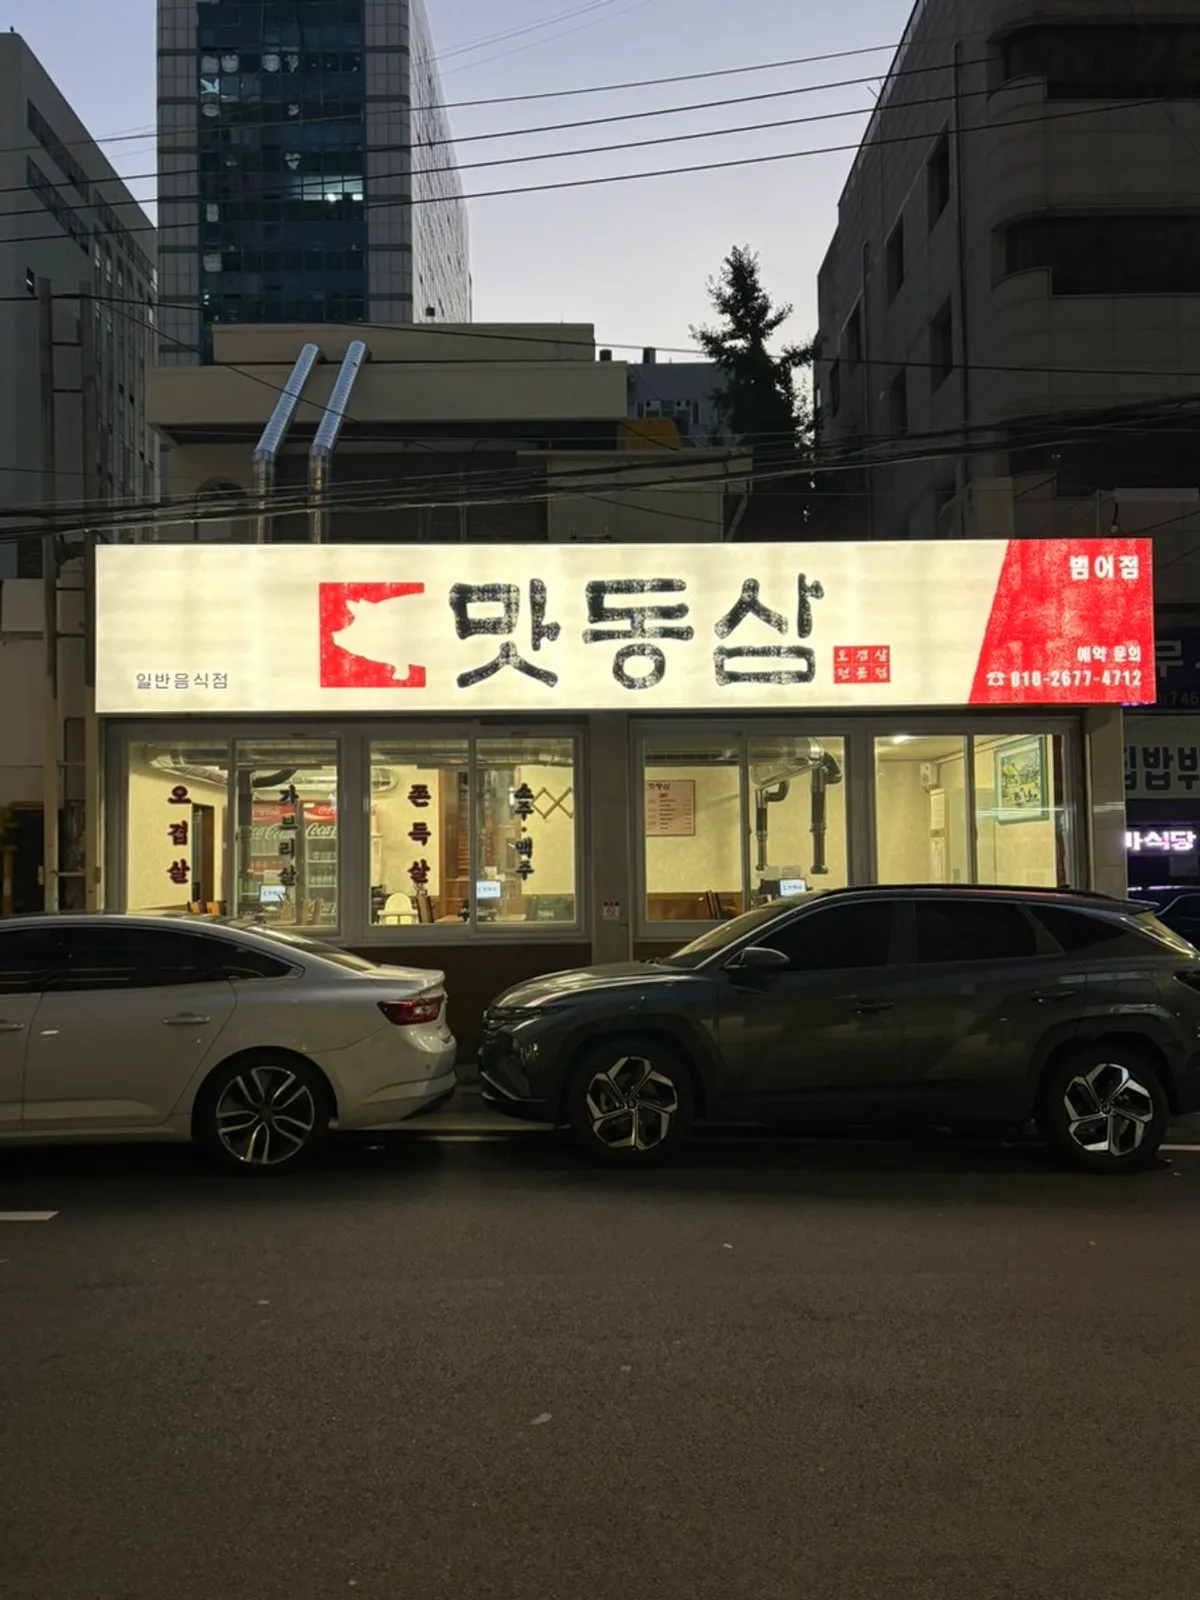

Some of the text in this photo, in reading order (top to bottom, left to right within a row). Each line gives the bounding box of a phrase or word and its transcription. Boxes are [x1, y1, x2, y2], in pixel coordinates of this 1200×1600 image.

[1069, 555, 1139, 580] 범어점
[450, 572, 825, 690] 맛동삼
[1077, 645, 1141, 663] 예약 문의
[136, 673, 228, 689] 일반음식점
[1011, 670, 1141, 687] 010-2677-4712
[167, 785, 192, 884] 오겹살
[278, 784, 299, 886] 가브리살
